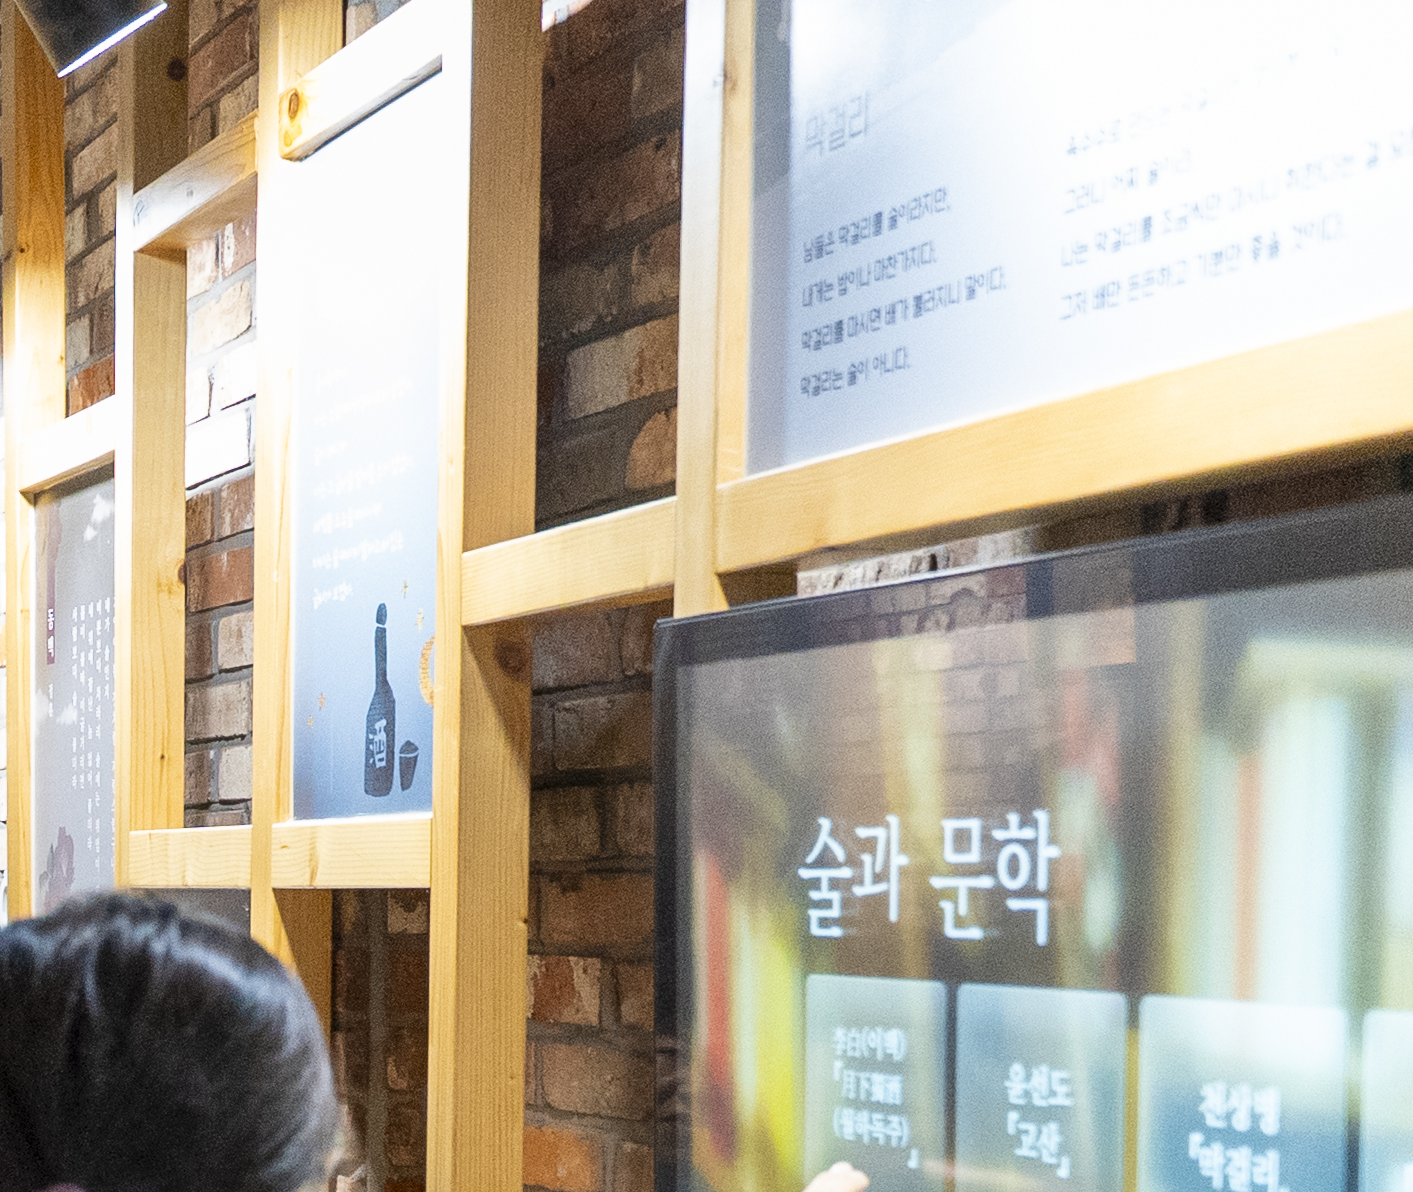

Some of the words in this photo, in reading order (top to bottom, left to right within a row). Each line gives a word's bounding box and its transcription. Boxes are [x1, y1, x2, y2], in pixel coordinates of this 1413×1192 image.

[804, 92, 870, 156] 막걸리
[802, 230, 835, 264] 남들은
[837, 210, 884, 247] 막걸리를
[1062, 240, 1089, 267] 나는
[1095, 214, 1153, 253] 막걸리를
[801, 277, 835, 308] 내게는
[837, 262, 872, 297] 밥이나
[1060, 289, 1087, 321] 그저
[1092, 280, 1122, 310] 배만
[1127, 258, 1187, 302] 든든하고
[801, 318, 844, 351] 막걸리를
[846, 307, 882, 339] 마시면
[884, 298, 909, 326] 배가
[799, 367, 844, 398] 막걸리는
[846, 358, 870, 388] 술이
[797, 813, 911, 938] 술과
[929, 808, 1063, 948] 문학
[1004, 1062, 1073, 1108] 윤선도
[1198, 1080, 1282, 1137] 천상병
